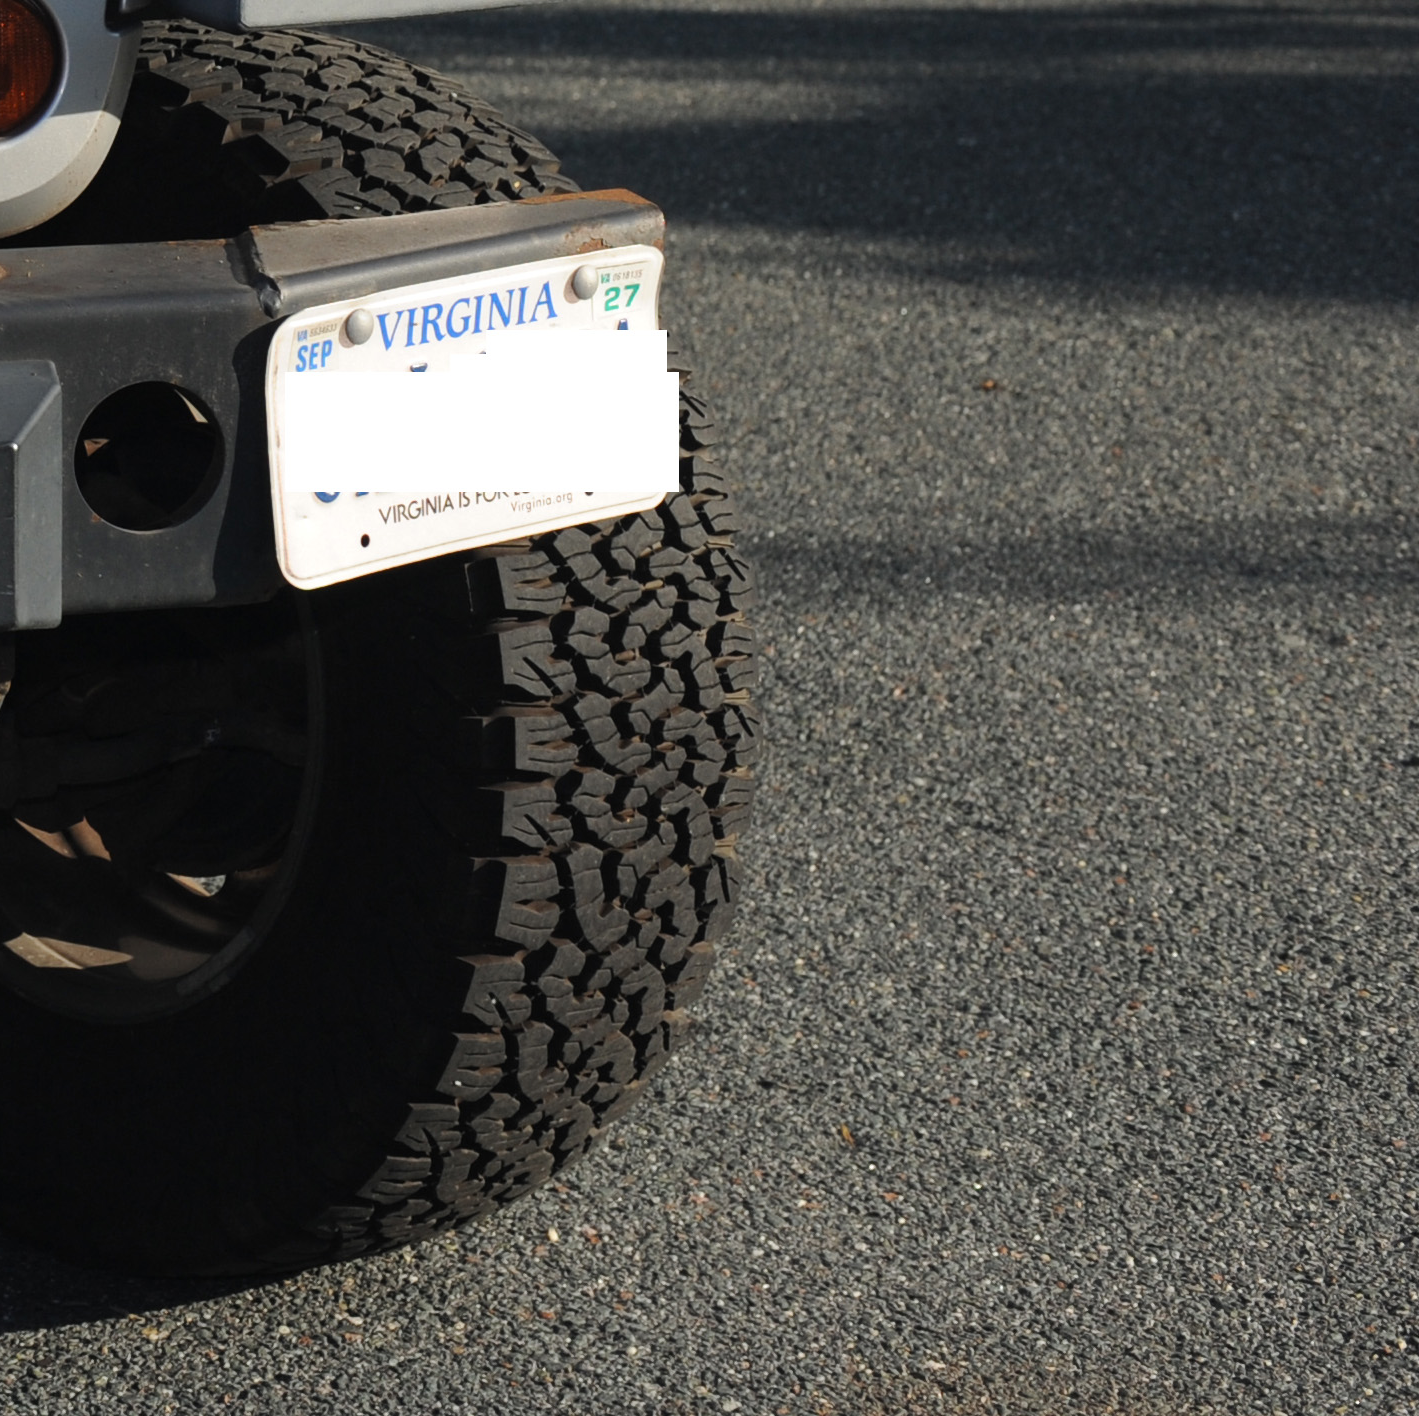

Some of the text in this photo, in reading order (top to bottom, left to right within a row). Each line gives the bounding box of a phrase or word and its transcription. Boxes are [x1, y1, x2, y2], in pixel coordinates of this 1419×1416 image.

[604, 283, 640, 311] 27
[376, 281, 558, 351] VIRGINIA
[295, 339, 333, 372] SEP
[378, 493, 454, 524] VIRGINIA
[459, 492, 470, 508] IS
[511, 492, 573, 512] Virginia.org
